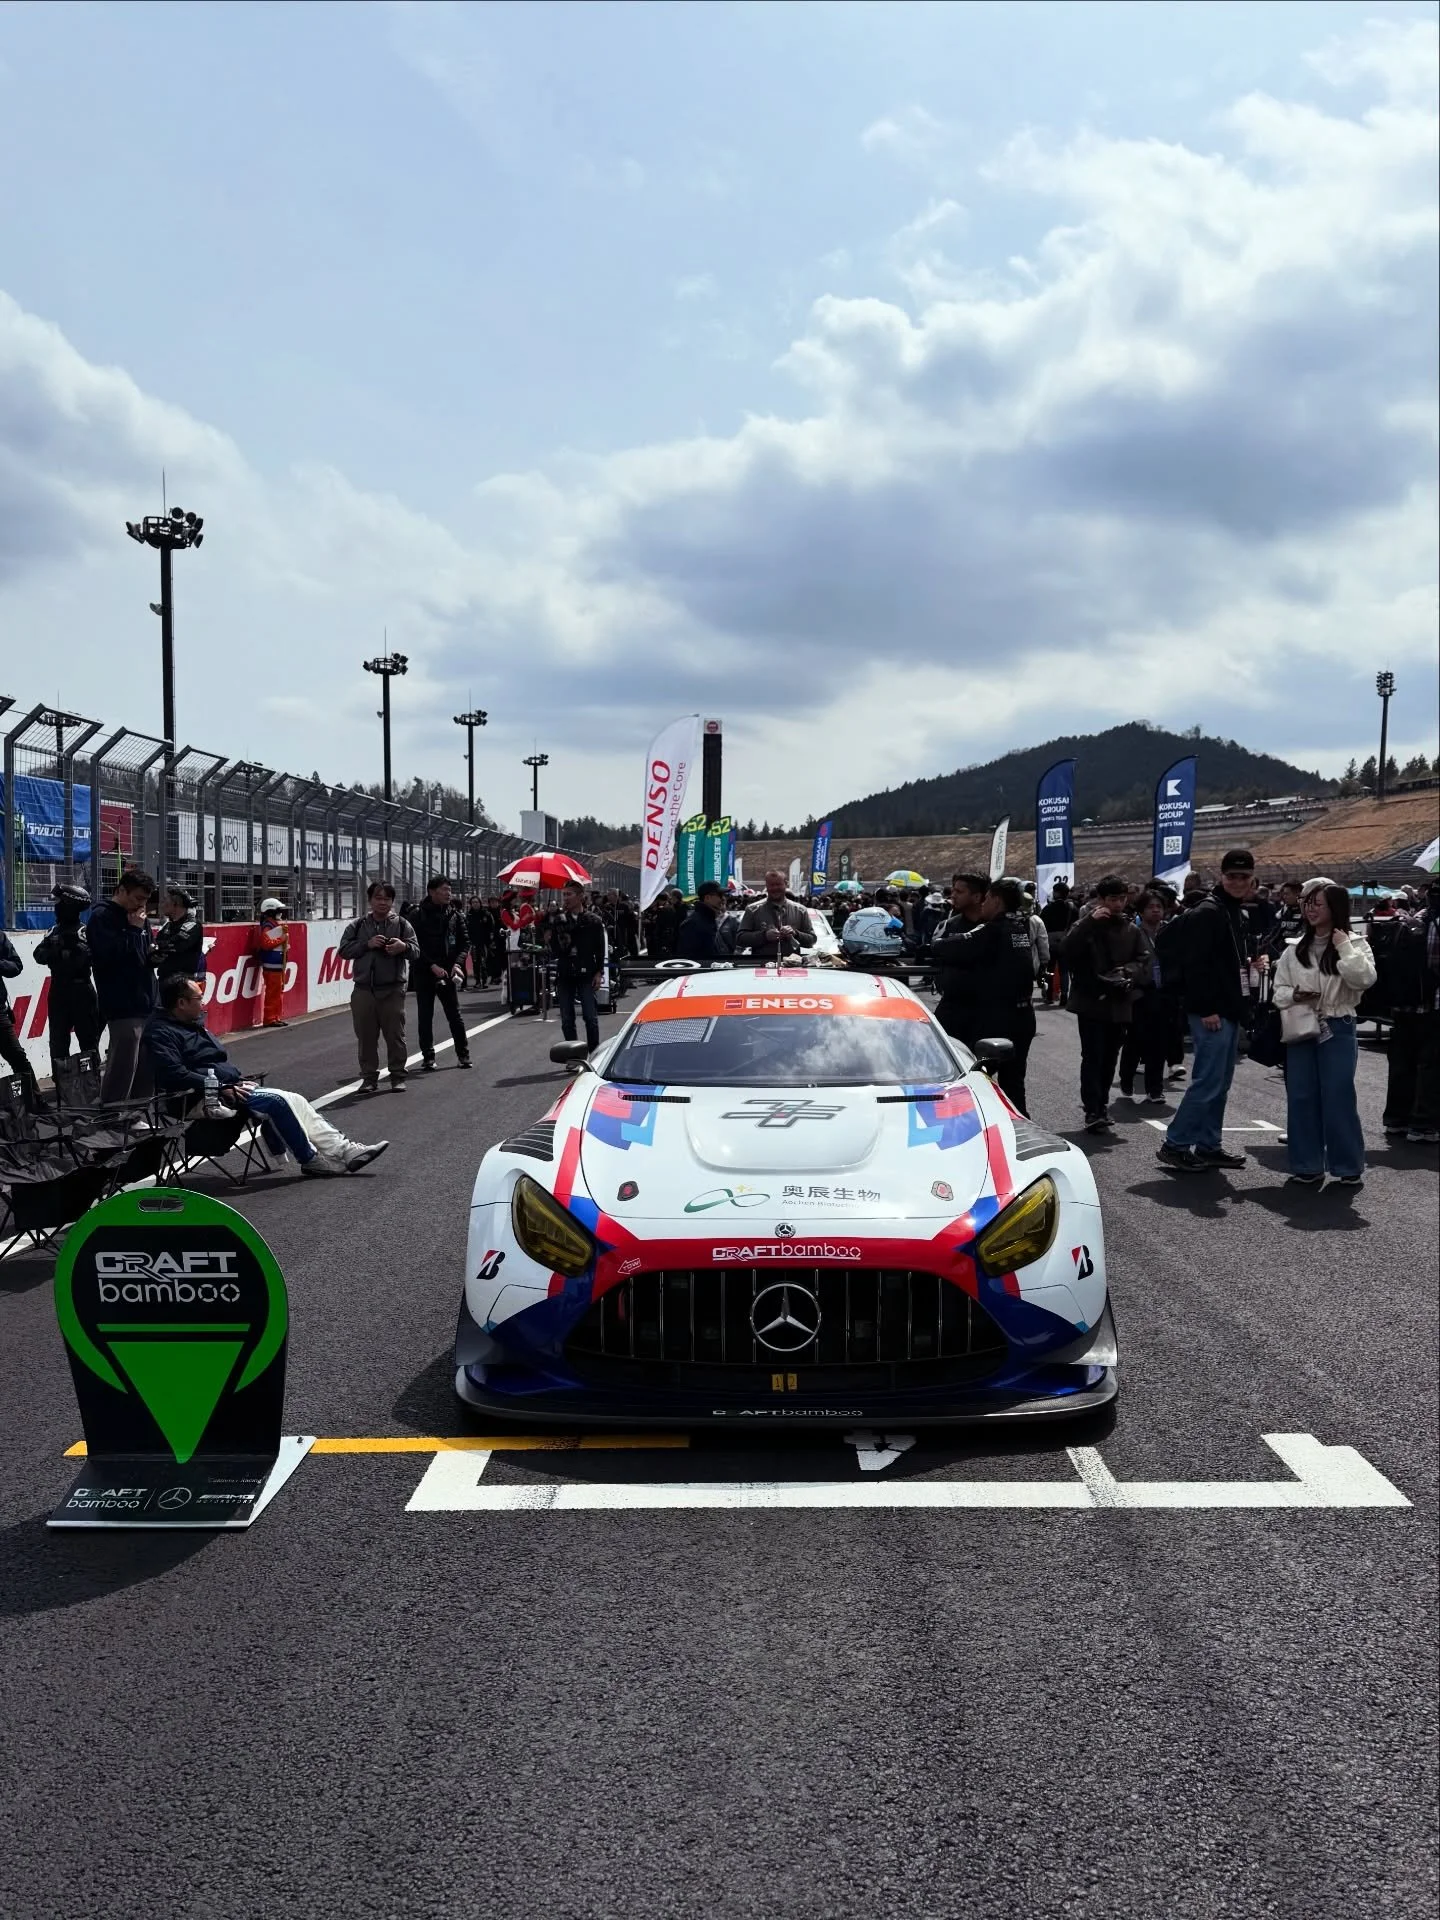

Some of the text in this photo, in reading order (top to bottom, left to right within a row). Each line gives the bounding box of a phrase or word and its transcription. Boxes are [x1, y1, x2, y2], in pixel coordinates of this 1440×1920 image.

[672, 761, 687, 792] Core
[669, 791, 681, 817] the
[1038, 797, 1070, 807] KOKUSAI
[1159, 802, 1191, 811] KOKUSAI
[646, 760, 671, 870] DENSO
[1041, 806, 1067, 814] GROUP
[1159, 811, 1184, 819] GROUP
[746, 998, 834, 1009] ENEOS
[95, 1251, 237, 1281] CRAFT
[98, 1279, 241, 1303] bamboo
[66, 1499, 140, 1509] bamboo
